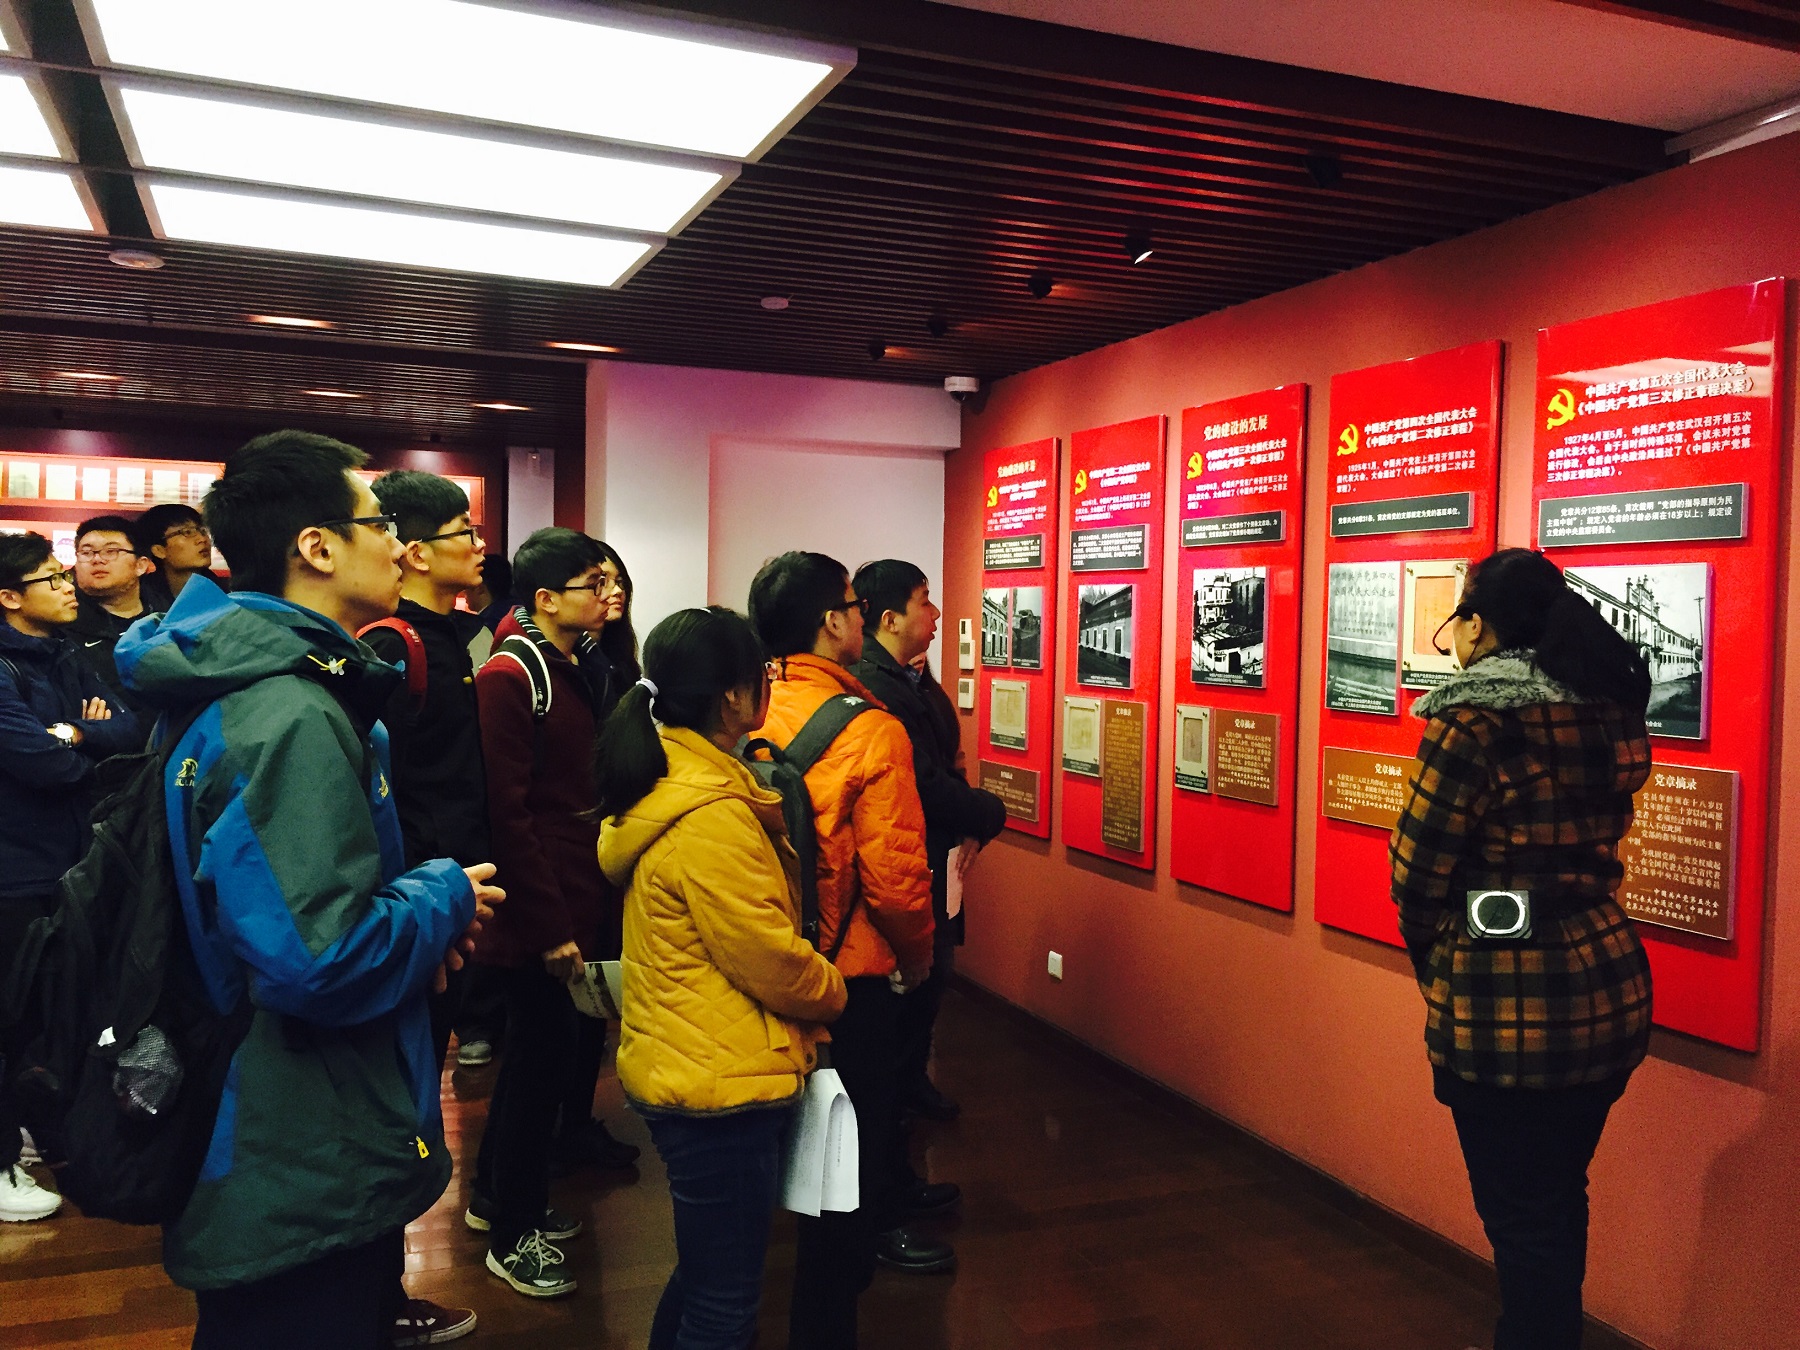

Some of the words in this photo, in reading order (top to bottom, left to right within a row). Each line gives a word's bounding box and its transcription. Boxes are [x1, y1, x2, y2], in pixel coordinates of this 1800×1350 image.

[1586, 361, 1747, 398] 中国共产党第五次全国代表大会
[1578, 377, 1754, 416] 《中国共产党第三次修正章程决案》
[1204, 414, 1268, 441] 党的建设的发展
[1364, 407, 1477, 436] 中国共产党第四次全国代表大会
[1366, 421, 1474, 448] 《中国共产党第二次修正章程》
[1564, 412, 1751, 445] 1927年4月至5月，中国共产党在武汉召开第五次
[1654, 773, 1697, 791] 党章摘录
[1636, 810, 1723, 830] 党者，必须经过青年团，但
